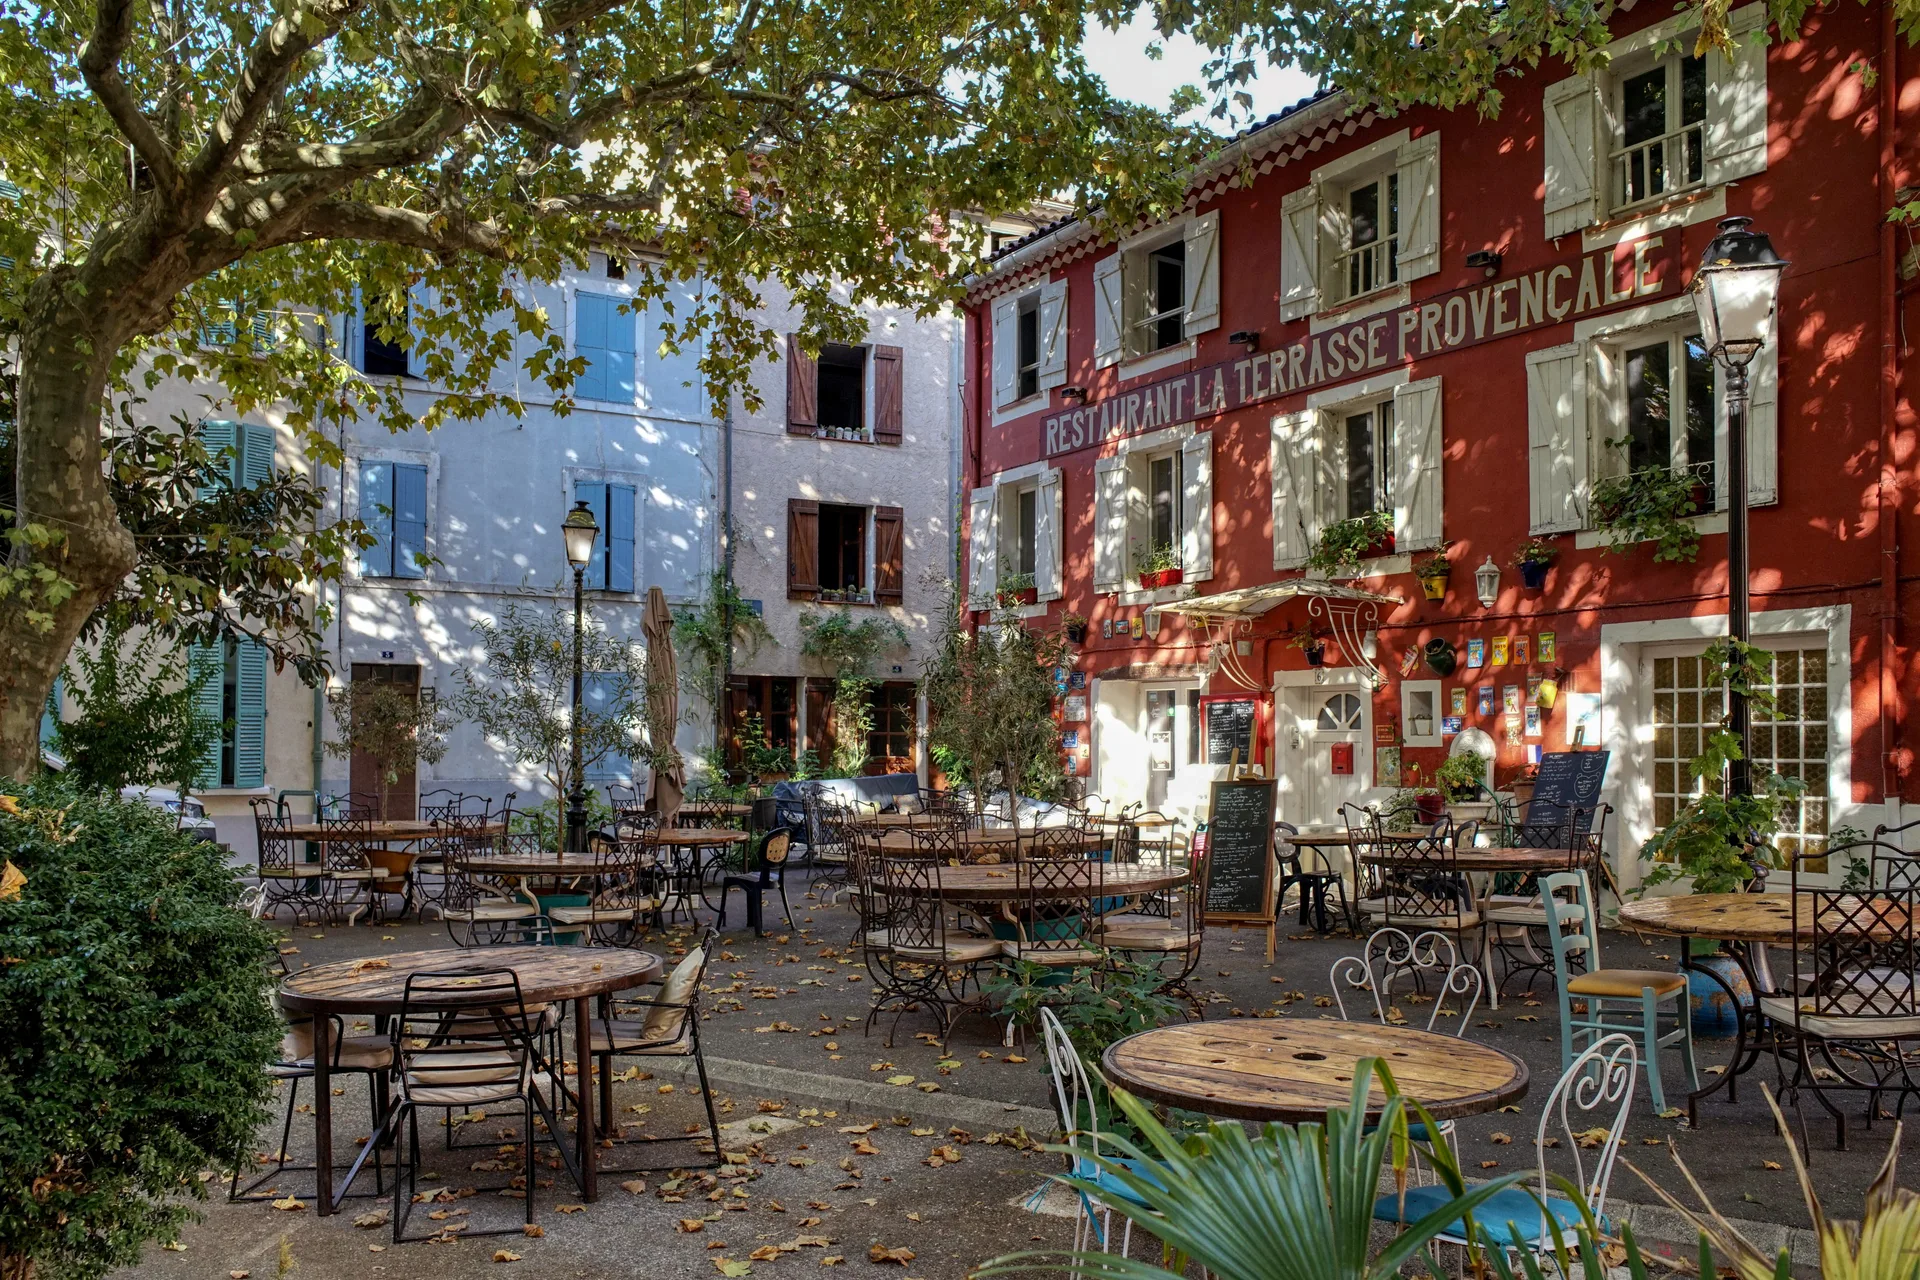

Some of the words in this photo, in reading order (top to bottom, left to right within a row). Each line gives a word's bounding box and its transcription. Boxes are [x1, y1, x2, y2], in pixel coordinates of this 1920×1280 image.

[1046, 378, 1188, 456] RESTAURANT
[1193, 367, 1227, 416] LA
[1234, 317, 1388, 395] TERRASSE
[1398, 236, 1664, 361] PROVENÇALE
